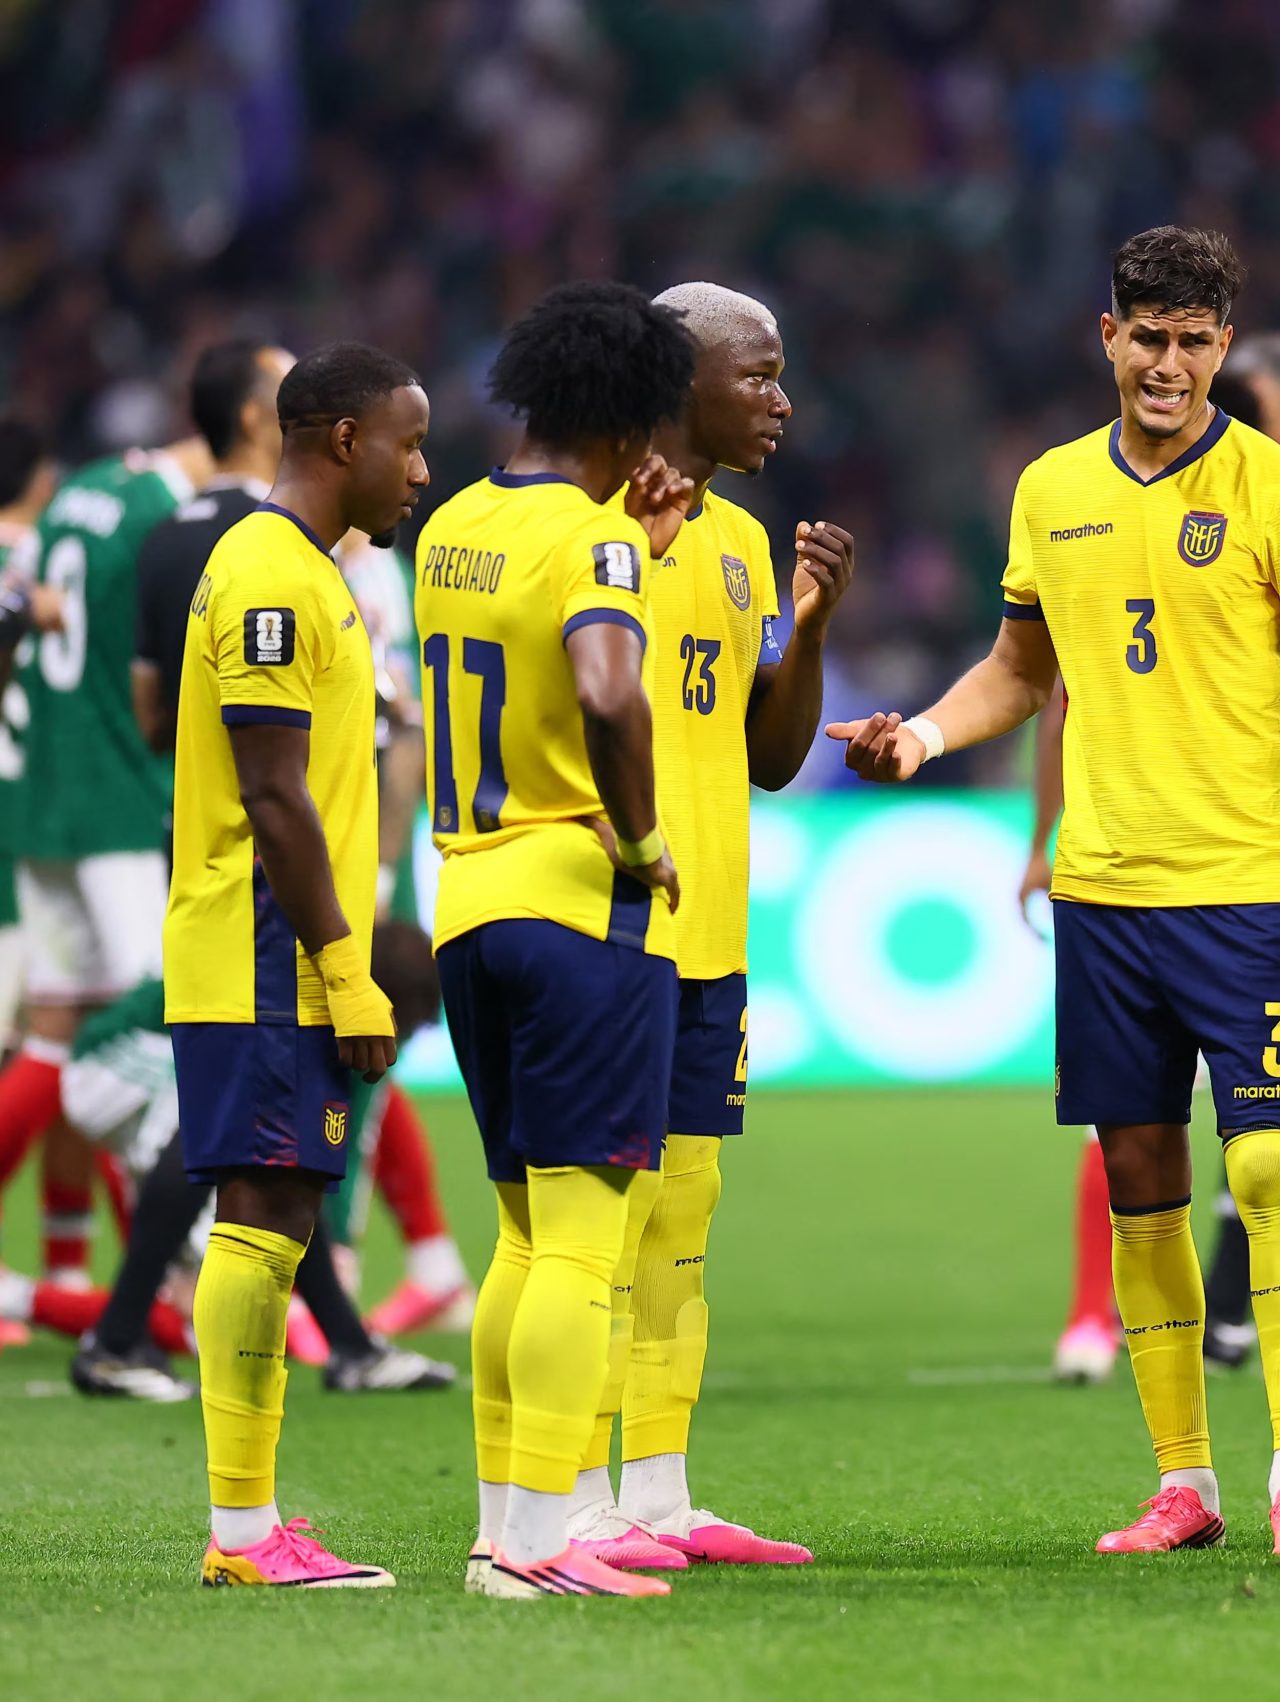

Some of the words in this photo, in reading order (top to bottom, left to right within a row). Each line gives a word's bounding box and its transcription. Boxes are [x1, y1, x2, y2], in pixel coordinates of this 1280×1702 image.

[1050, 522, 1114, 543] marathon
[422, 545, 506, 595] PRECIADO
[1125, 598, 1158, 675] 3
[680, 633, 722, 716] 23
[423, 633, 511, 835] 17
[1124, 1319, 1199, 1336] marathon
